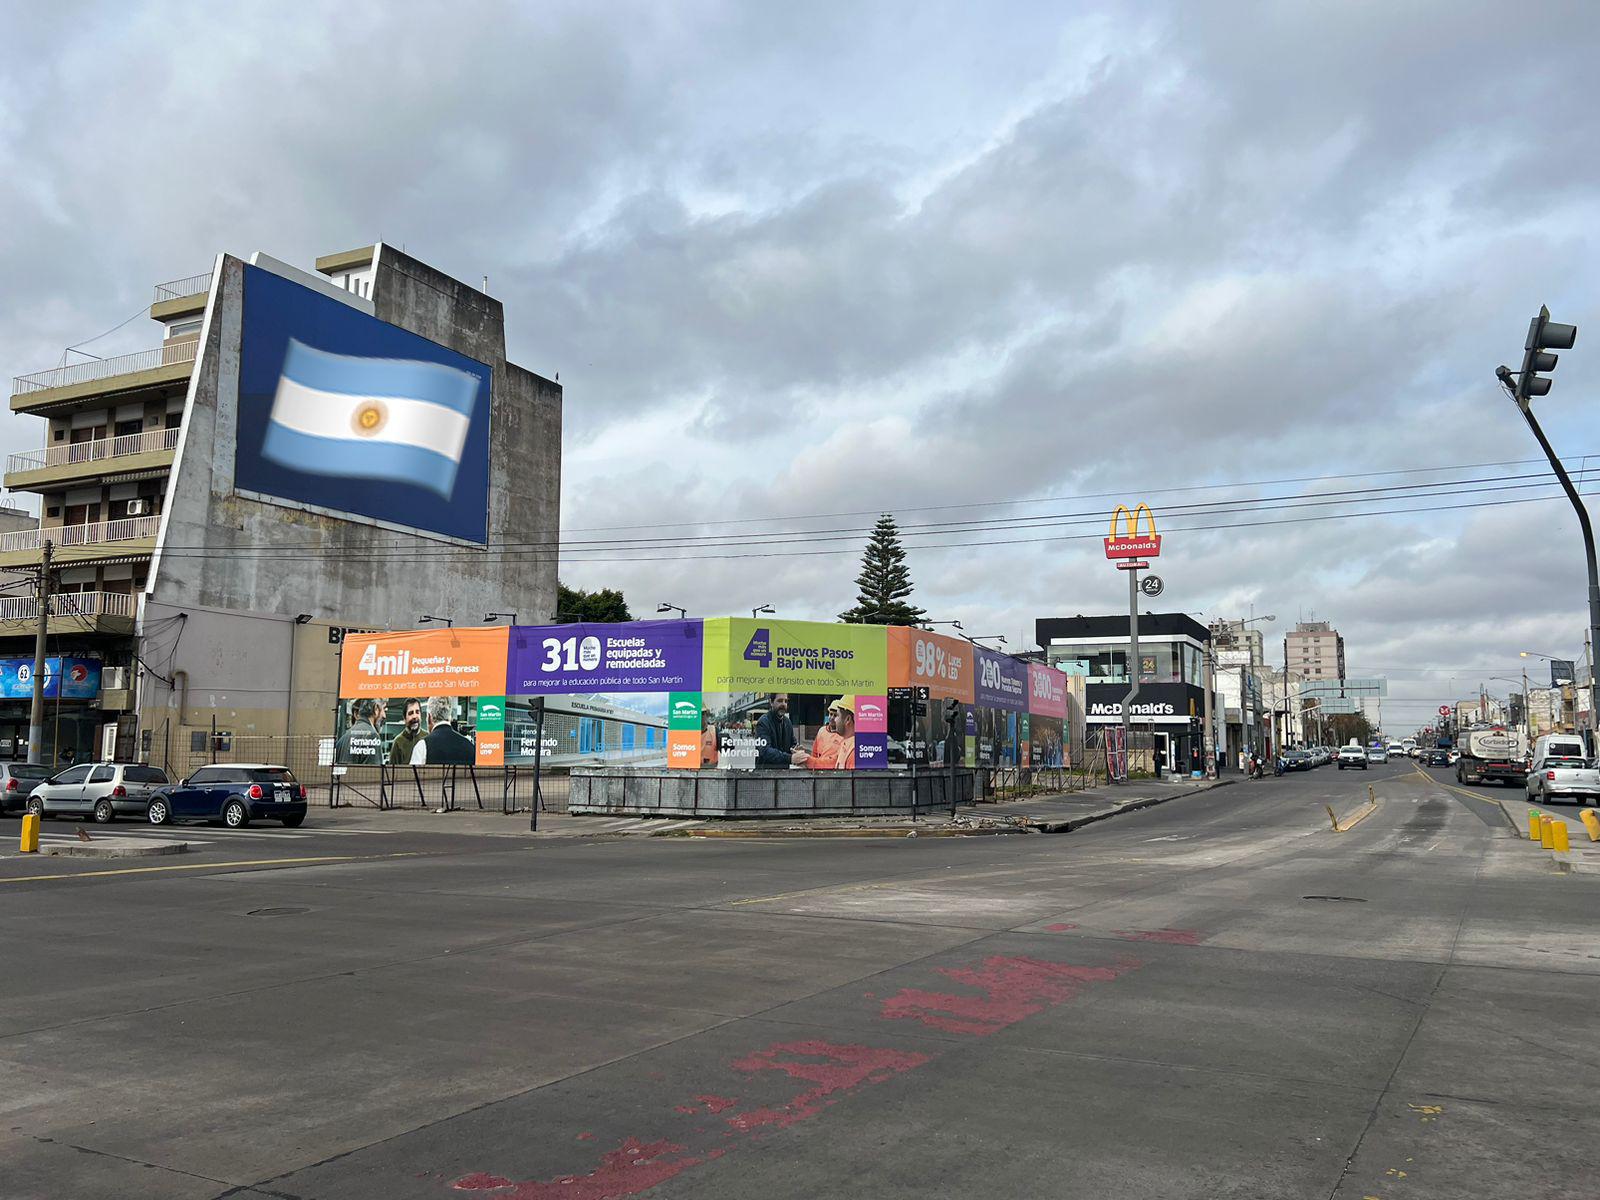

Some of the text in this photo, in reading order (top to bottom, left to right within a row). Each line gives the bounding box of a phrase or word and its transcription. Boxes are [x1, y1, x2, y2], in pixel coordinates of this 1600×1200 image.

[1108, 542, 1157, 551] McDonald's
[1145, 579, 1159, 589] 24
[606, 637, 645, 648] Escuelas
[743, 628, 773, 668] 4
[541, 636, 601, 672] 310
[606, 647, 662, 660] equipadas y
[776, 646, 854, 660] nuevos Pasos
[358, 644, 411, 676] 4mil
[411, 656, 453, 666] Pequeñas y
[606, 657, 666, 669] remodeladas
[776, 657, 835, 671] Bajo Nivel
[916, 639, 947, 679] 98%
[411, 664, 480, 675] Medianas Empresas
[979, 656, 1001, 690] 200
[523, 680, 537, 688] para
[538, 679, 561, 688] mejorar
[562, 678, 568, 686] la
[568, 677, 599, 686] educación
[599, 677, 621, 687] pública
[622, 677, 632, 685] de
[632, 676, 647, 685] todo
[648, 676, 660, 684] San
[717, 676, 734, 685] para
[736, 676, 765, 686] mejorar
[767, 676, 775, 685] el
[817, 678, 834, 686] todo
[835, 678, 849, 687] San
[1091, 702, 1174, 715] McDnald's
[350, 737, 381, 747] Fernando
[672, 743, 697, 751] Somos
[721, 737, 767, 747] Fernando
[350, 746, 376, 755] Moreira
[520, 747, 551, 756] Morira
[721, 747, 760, 757] Moreira
[859, 744, 882, 753] Somos
